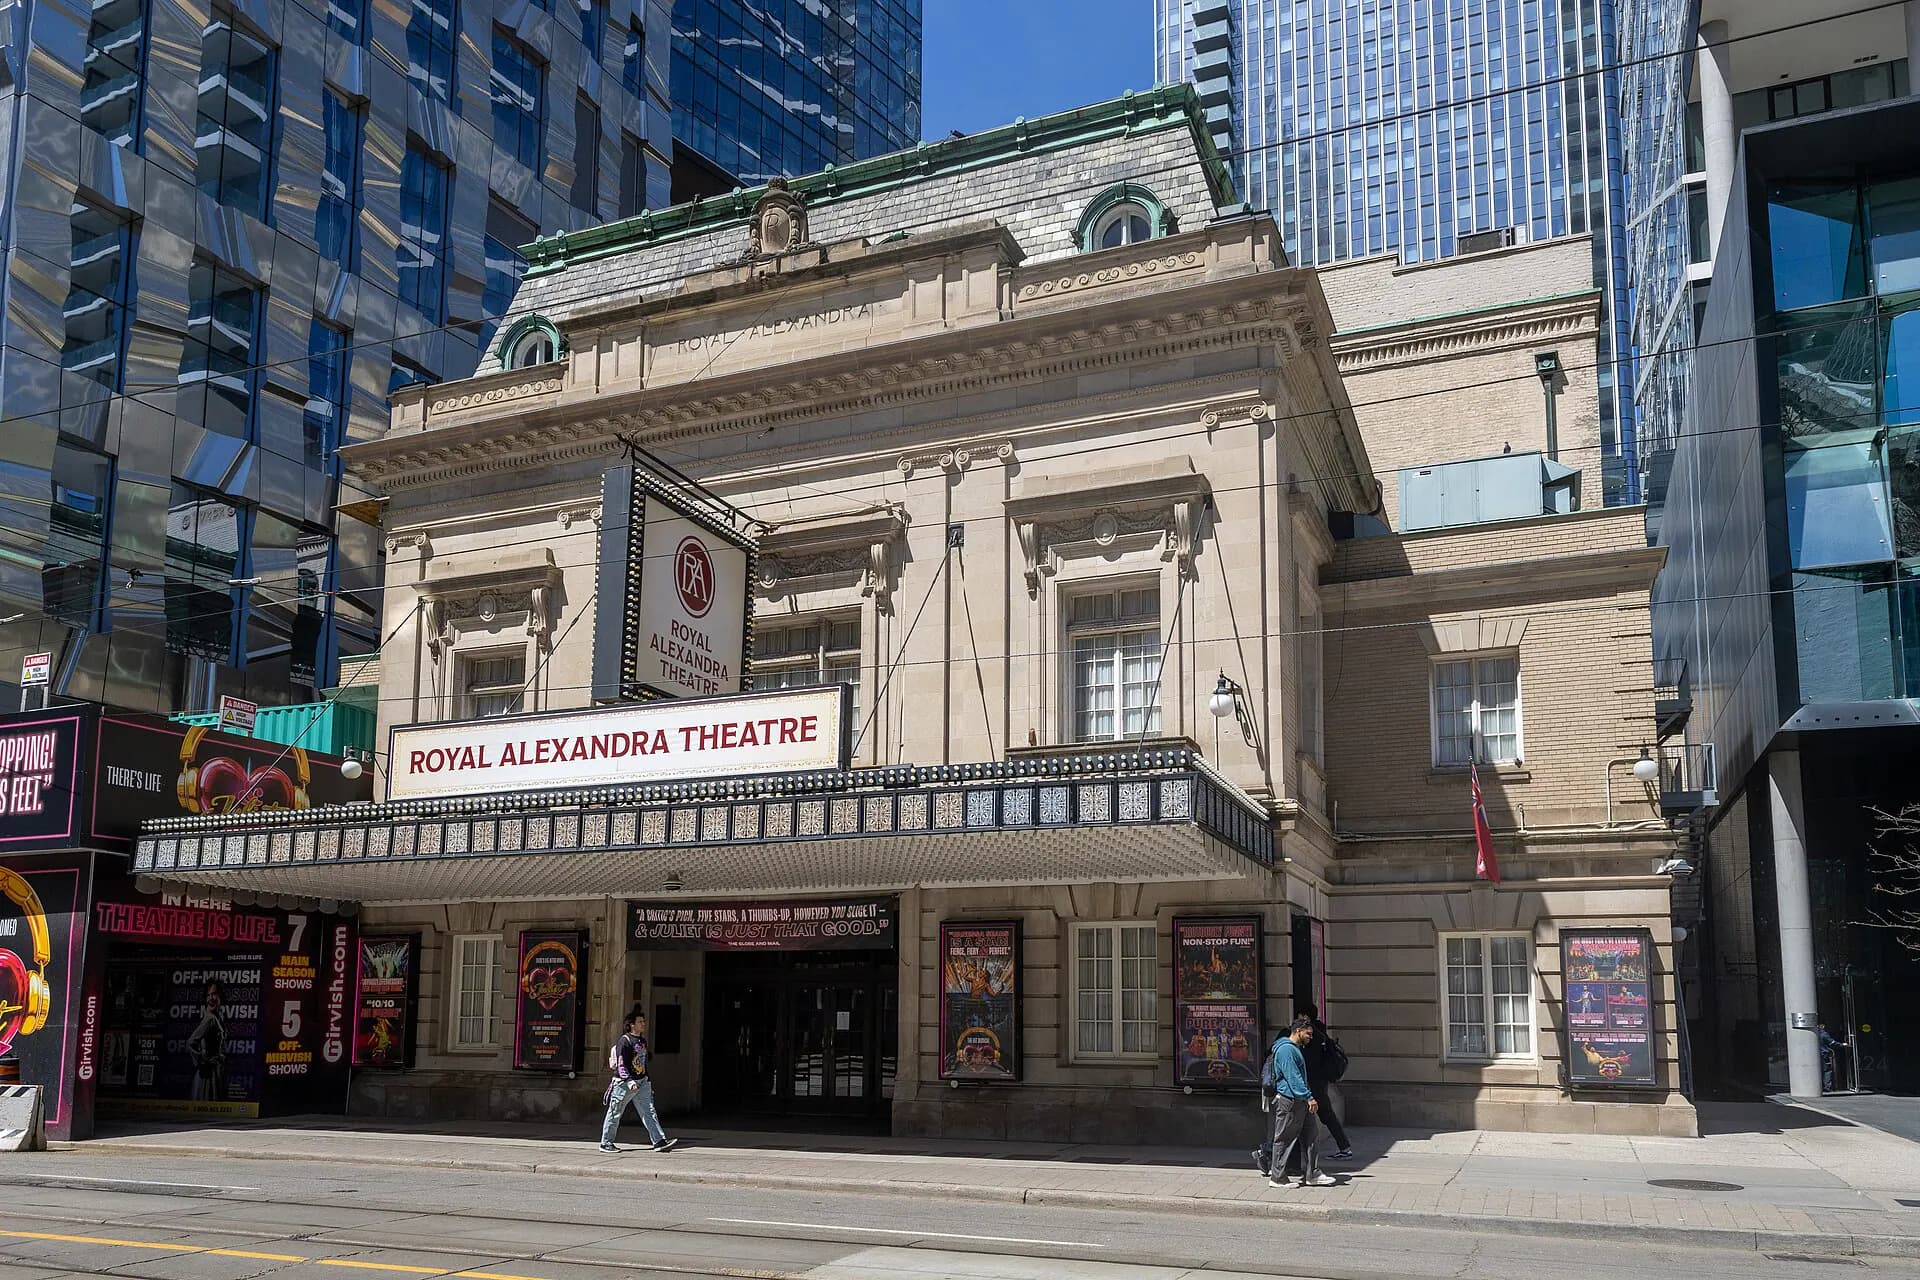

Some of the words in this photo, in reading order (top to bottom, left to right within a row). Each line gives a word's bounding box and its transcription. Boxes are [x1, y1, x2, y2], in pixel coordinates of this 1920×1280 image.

[678, 331, 733, 354] ROYAL
[750, 304, 871, 340] ALEXANDRA
[671, 619, 713, 653] ROYAL
[650, 633, 729, 681] ALEXANDRA
[660, 660, 719, 695] THEATRE
[409, 744, 492, 774] ROYAL
[499, 729, 670, 767] ALEXANDRA
[679, 715, 818, 751] THEATRE
[107, 766, 142, 789] THERE'S
[145, 772, 162, 792] LIFE
[162, 894, 182, 907] IN
[186, 896, 232, 911] HERE
[697, 909, 713, 922] FIVE
[714, 909, 739, 923] STARS,
[741, 909, 747, 922] A
[748, 907, 792, 923] THUMBS-UP,
[794, 906, 829, 921] HOWEVER
[831, 905, 847, 919] YOU
[869, 904, 877, 917] IT
[96, 902, 204, 938] THEATRE
[207, 912, 230, 939] IS
[233, 914, 281, 944] LIFE.
[288, 915, 307, 951] 7
[635, 924, 647, 938] &
[649, 924, 704, 938] JULIET
[705, 924, 722, 938] IS
[725, 923, 770, 938] JUST
[774, 922, 818, 937] THAT
[1183, 938, 1228, 946] NON-STOP
[272, 967, 316, 978] SEASON
[280, 955, 310, 966] MAIN
[274, 978, 313, 989] SHOWS
[323, 926, 347, 1063] mirvish.com
[281, 1001, 301, 1038] 5
[79, 996, 97, 1080] mirvish.com
[278, 1041, 301, 1051] OFF-
[265, 1051, 312, 1064] MIRVISH
[268, 1064, 308, 1076] SHOWS
